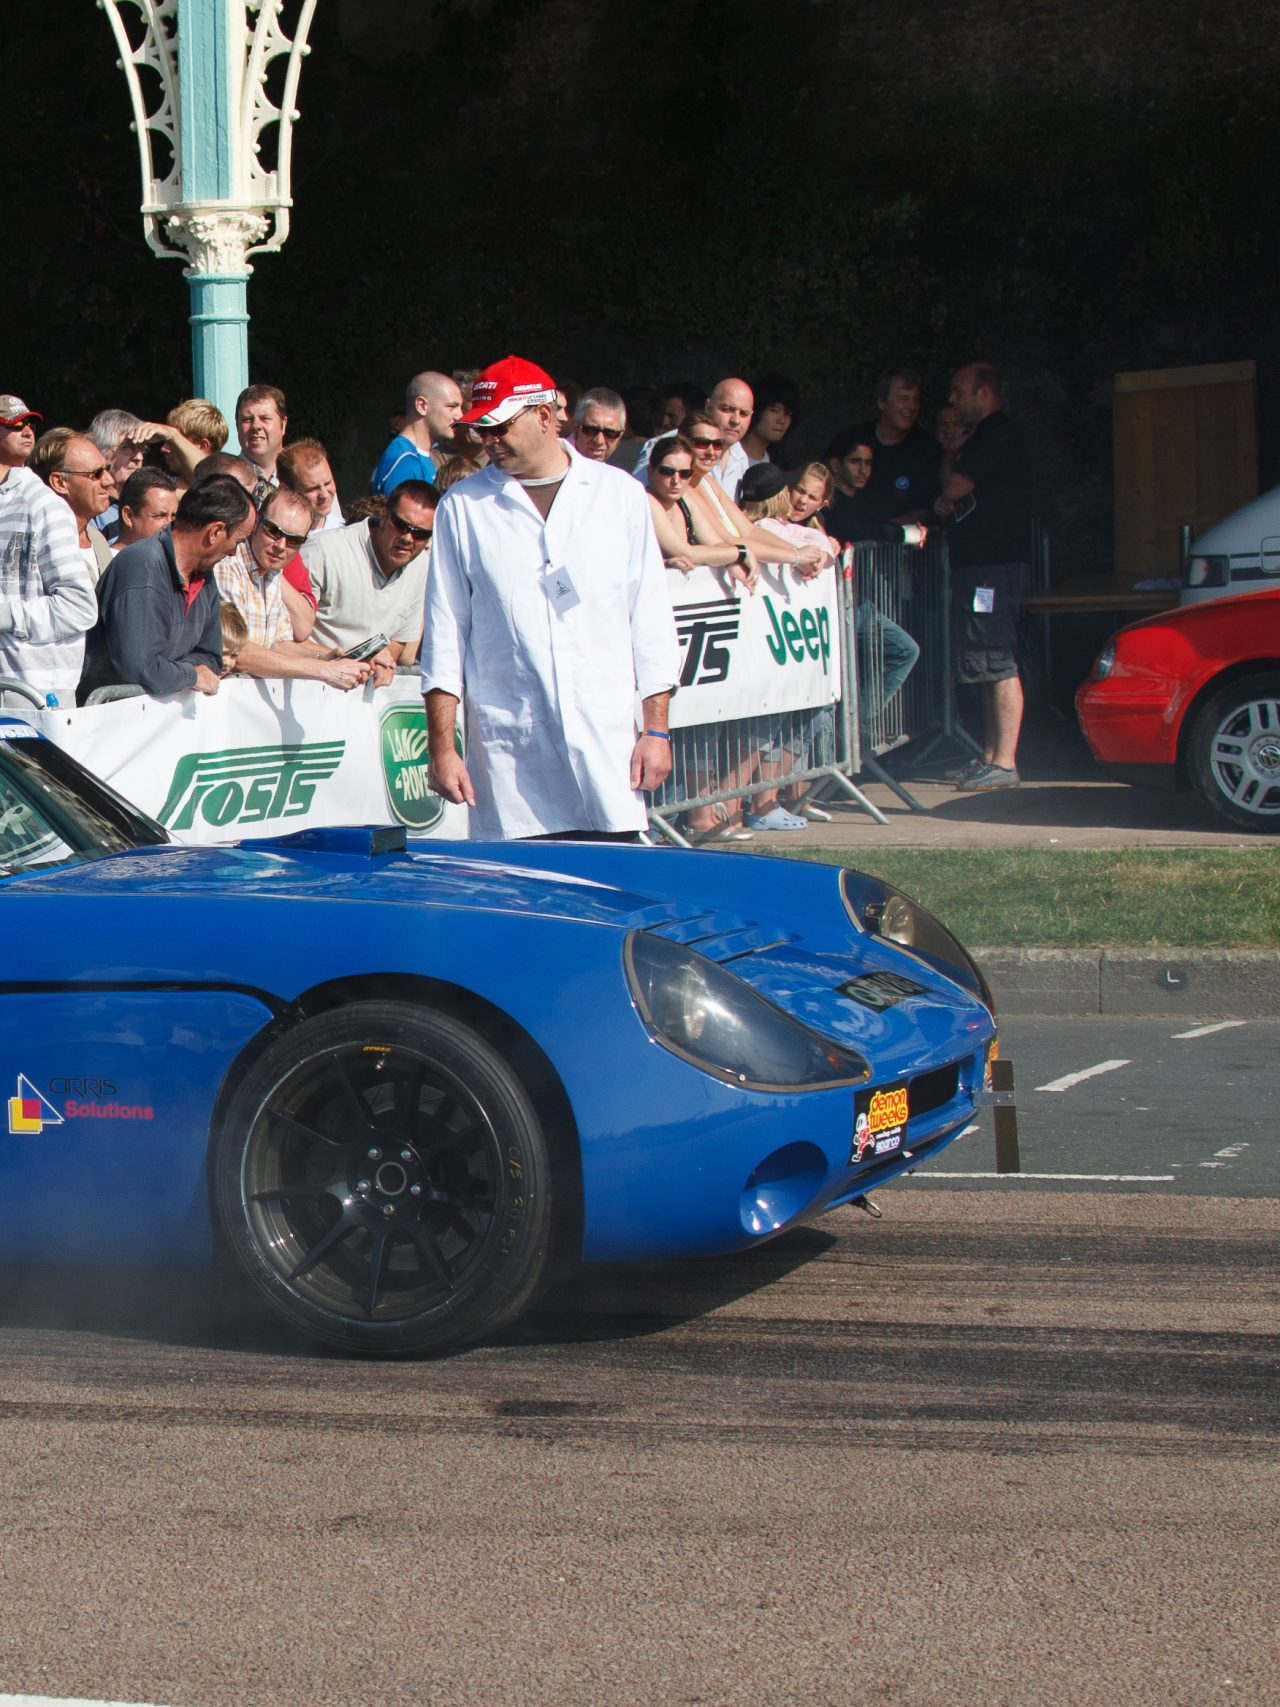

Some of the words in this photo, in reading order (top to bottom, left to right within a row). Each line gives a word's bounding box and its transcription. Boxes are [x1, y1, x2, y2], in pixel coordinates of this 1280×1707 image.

[762, 595, 830, 676] Jeep
[401, 764, 438, 801] ROVE
[48, 1078, 117, 1099] CIRRIS
[65, 1099, 154, 1120] Solutions
[871, 1089, 906, 1112] demon
[869, 1106, 907, 1129] tweeks
